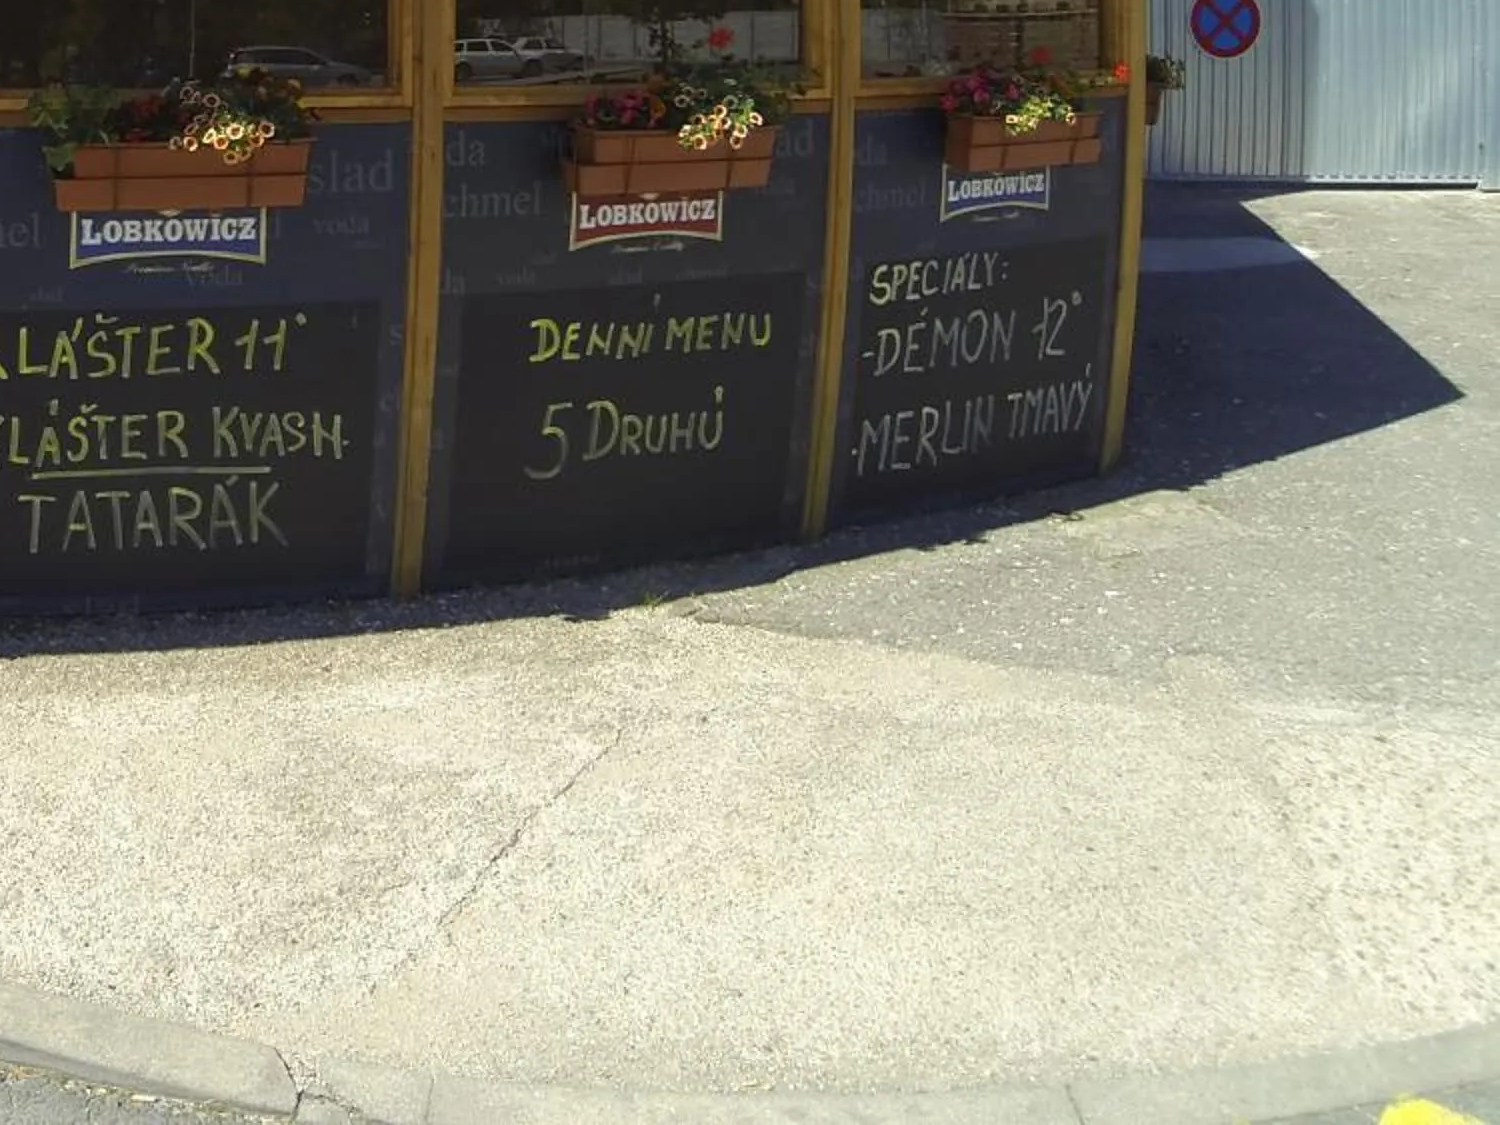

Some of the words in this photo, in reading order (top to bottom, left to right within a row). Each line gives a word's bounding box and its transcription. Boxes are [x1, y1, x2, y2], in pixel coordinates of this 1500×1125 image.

[947, 174, 1046, 202] LOBKOWICZ
[80, 216, 258, 246] LOBKOWICZ
[579, 197, 717, 229] LOBKOWICZ
[665, 311, 773, 357] MENU
[524, 402, 574, 480] 5
[17, 474, 289, 554] TATARÁK
